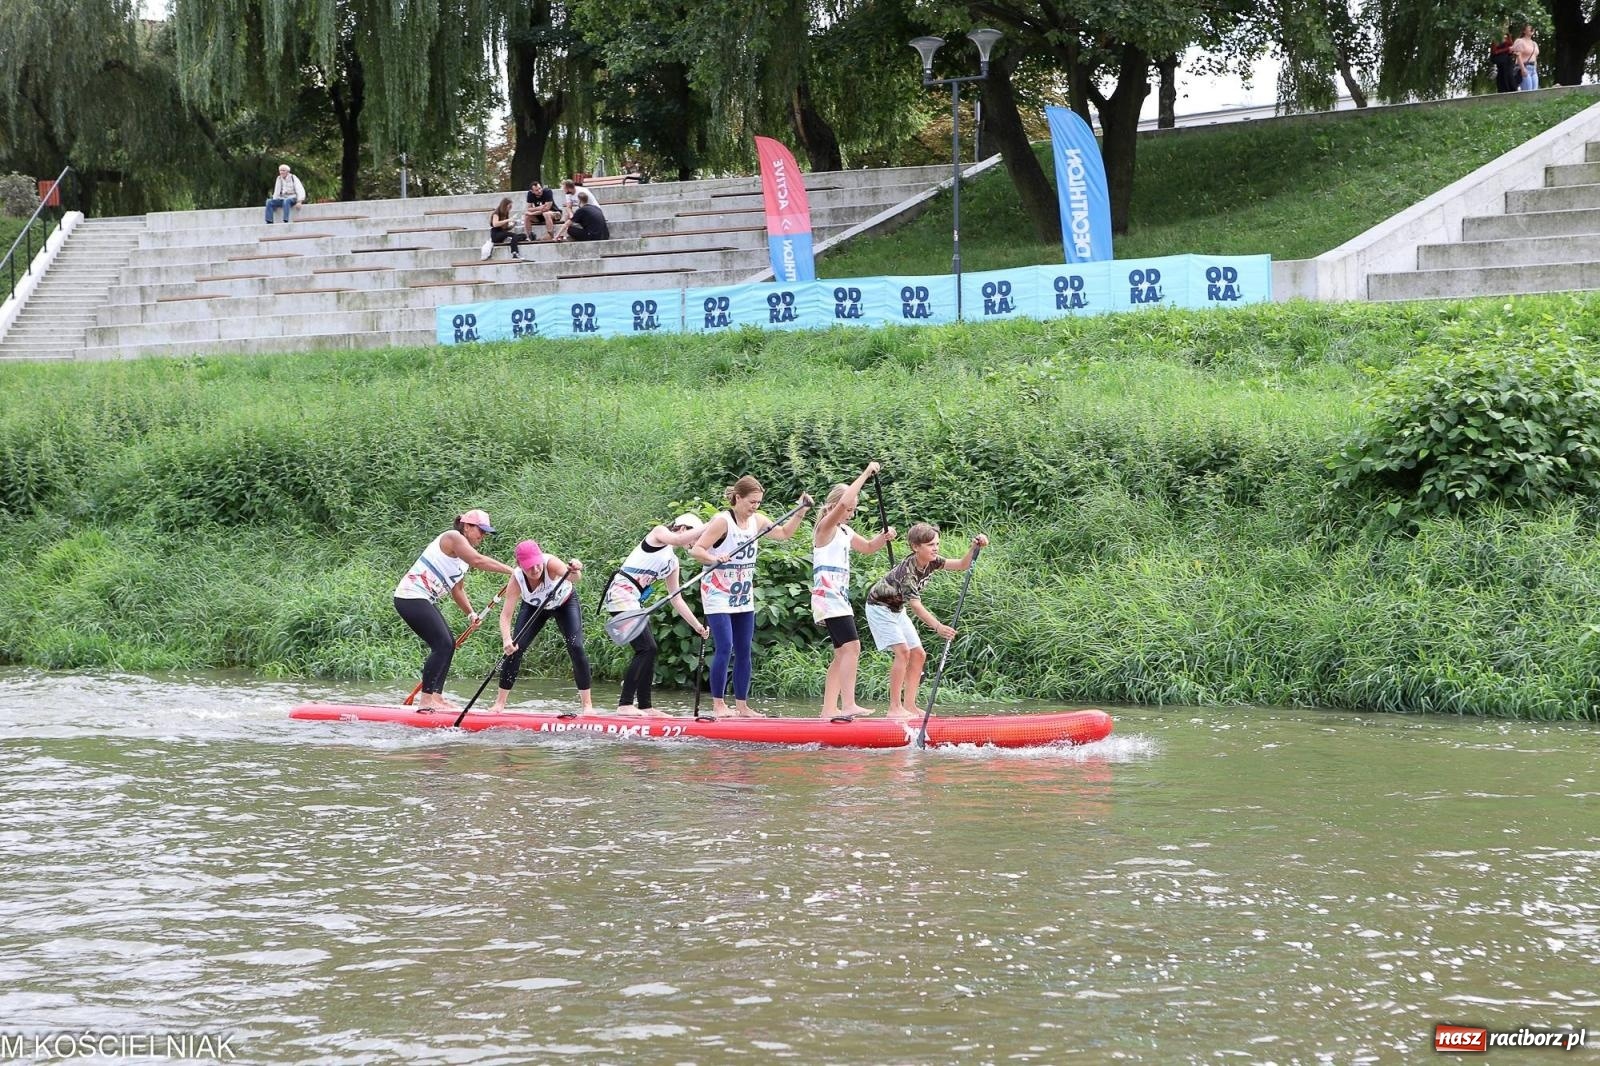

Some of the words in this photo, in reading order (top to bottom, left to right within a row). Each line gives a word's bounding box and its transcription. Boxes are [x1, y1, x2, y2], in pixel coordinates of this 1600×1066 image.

[1129, 269, 1160, 286] OD
[1206, 267, 1237, 283] OD
[982, 281, 1011, 298] OD
[1054, 276, 1084, 292] OD
[767, 292, 794, 308] OD
[834, 287, 861, 303] OD
[901, 286, 929, 302] OD
[572, 303, 595, 318] OD
[632, 300, 657, 315] OD
[704, 297, 729, 312] OD
[453, 314, 476, 328] OD
[512, 309, 535, 324] OD
